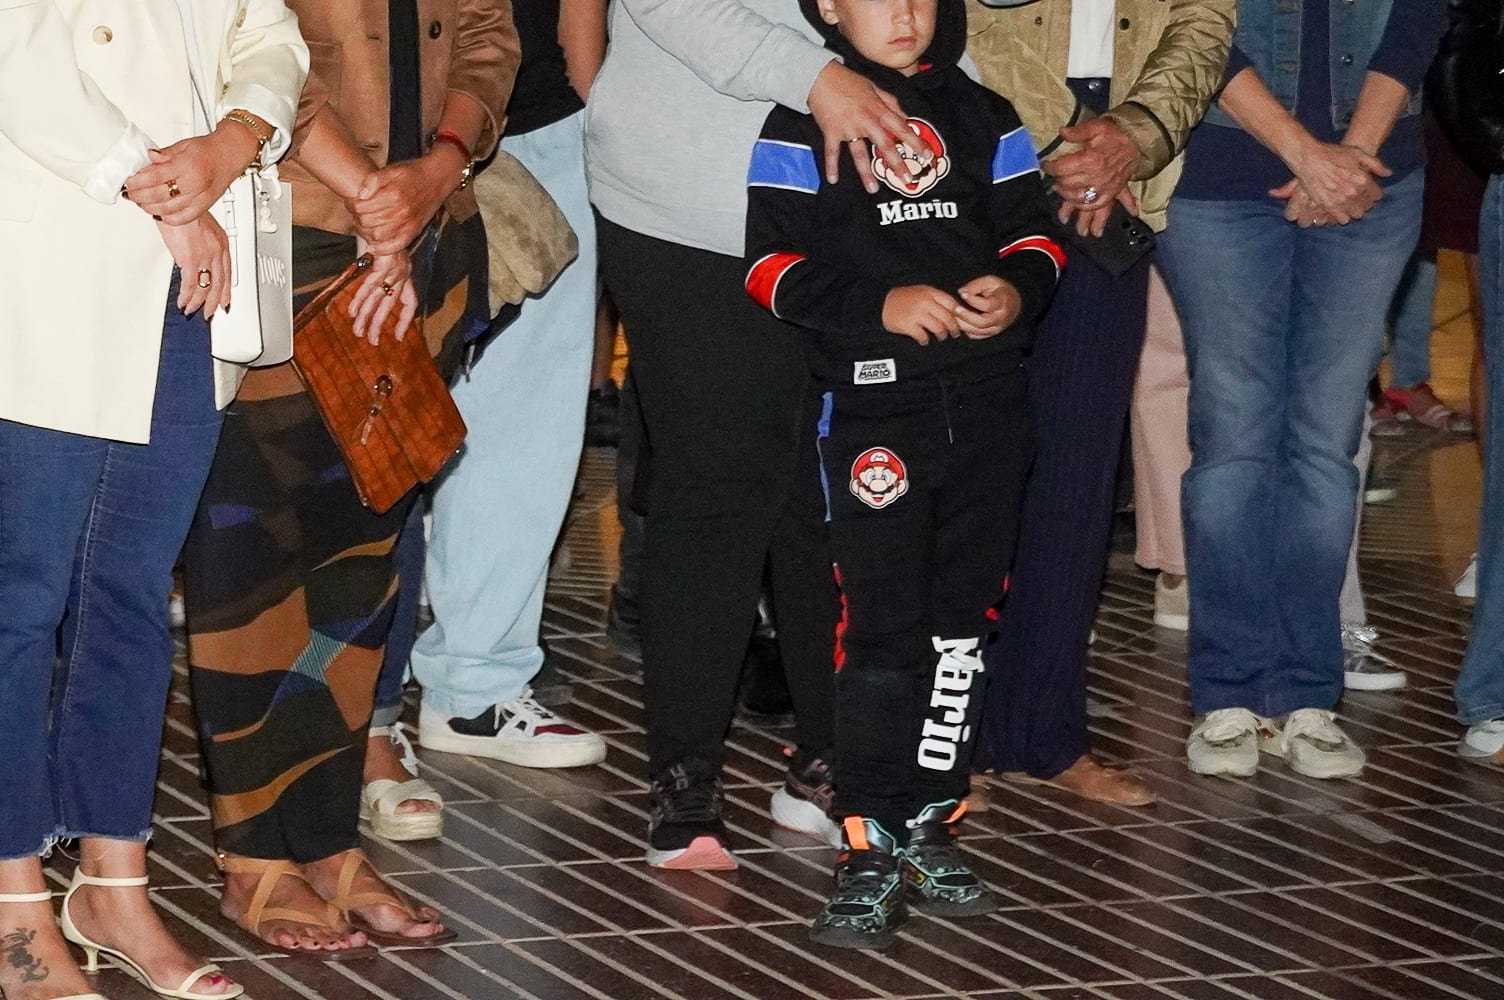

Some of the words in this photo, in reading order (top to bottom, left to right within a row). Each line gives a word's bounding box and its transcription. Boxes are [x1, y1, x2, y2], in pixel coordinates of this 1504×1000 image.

[877, 199, 958, 226] Mario
[858, 369, 891, 380] MARIO
[917, 635, 985, 772] Mario
